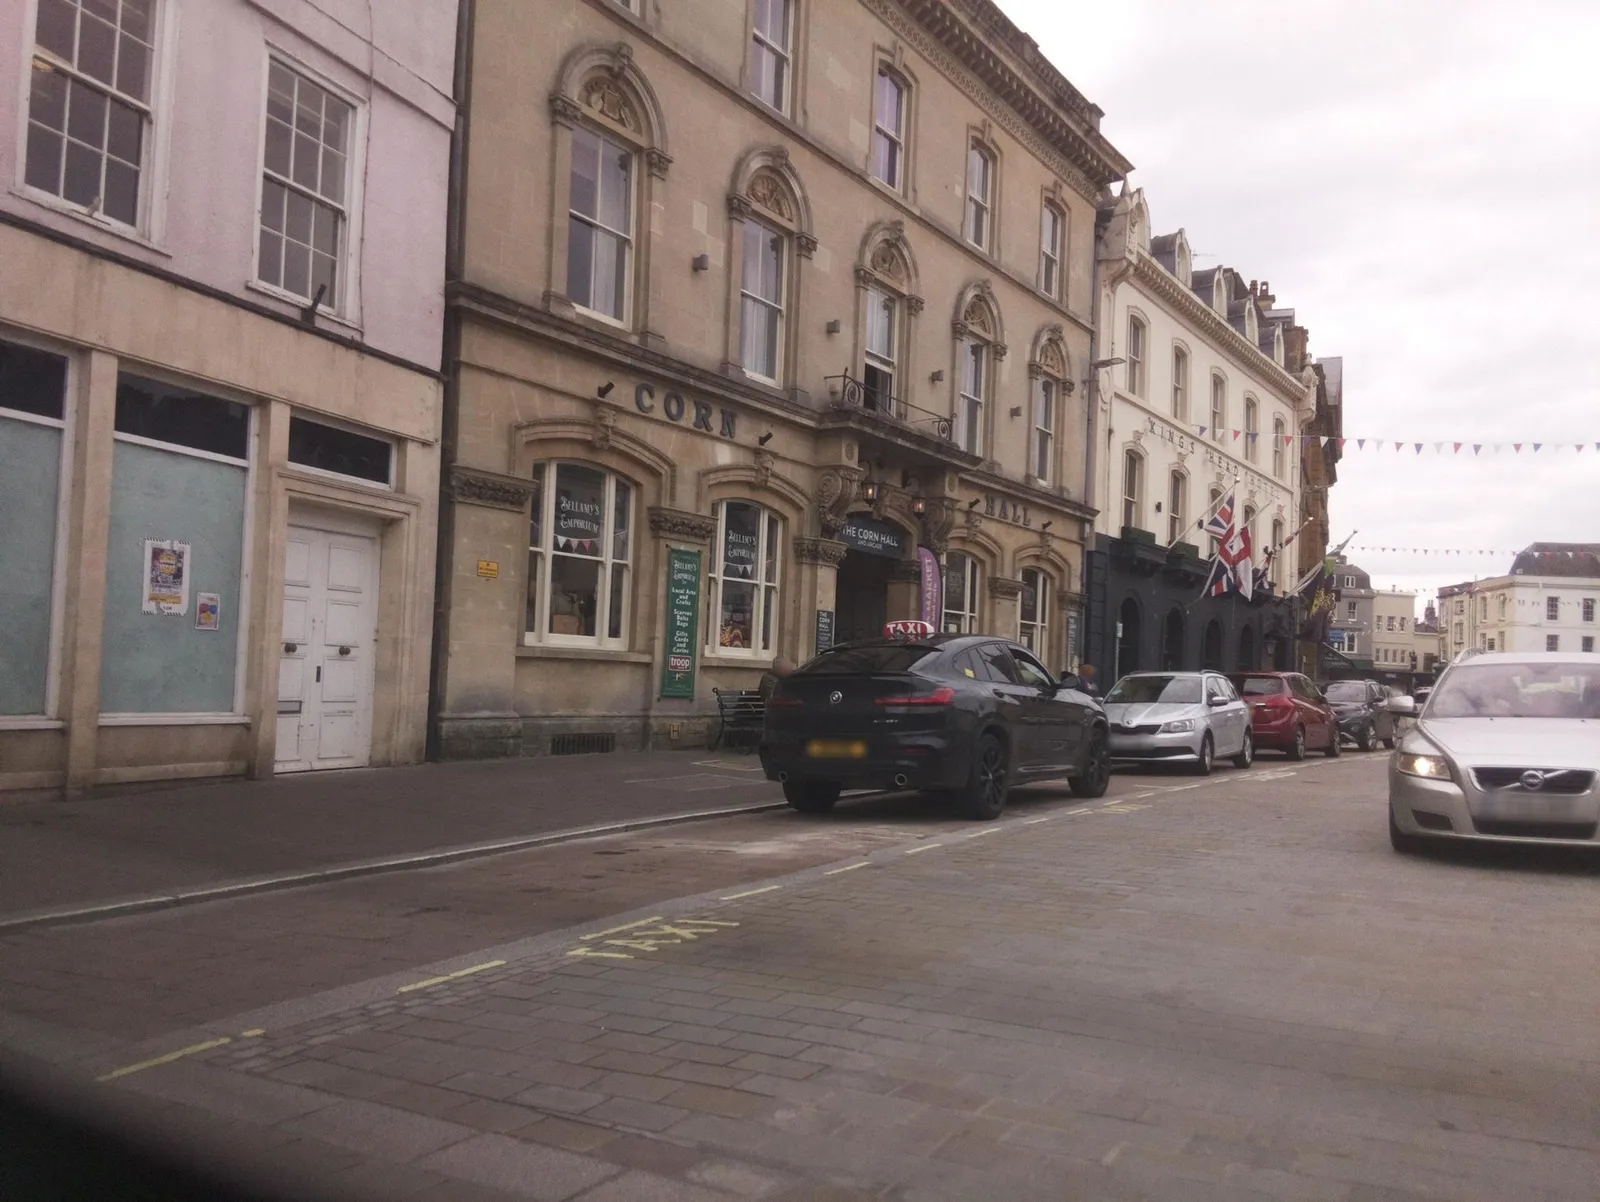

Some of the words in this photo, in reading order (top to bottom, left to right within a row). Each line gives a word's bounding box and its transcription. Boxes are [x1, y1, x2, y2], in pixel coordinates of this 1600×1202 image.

[1149, 420, 1194, 454] KINGS
[635, 383, 737, 439] CORN
[984, 494, 1031, 526] HALL
[842, 525, 856, 537] THE
[857, 528, 879, 541] CORN
[880, 532, 898, 547] HALL
[887, 622, 920, 635] TAXI
